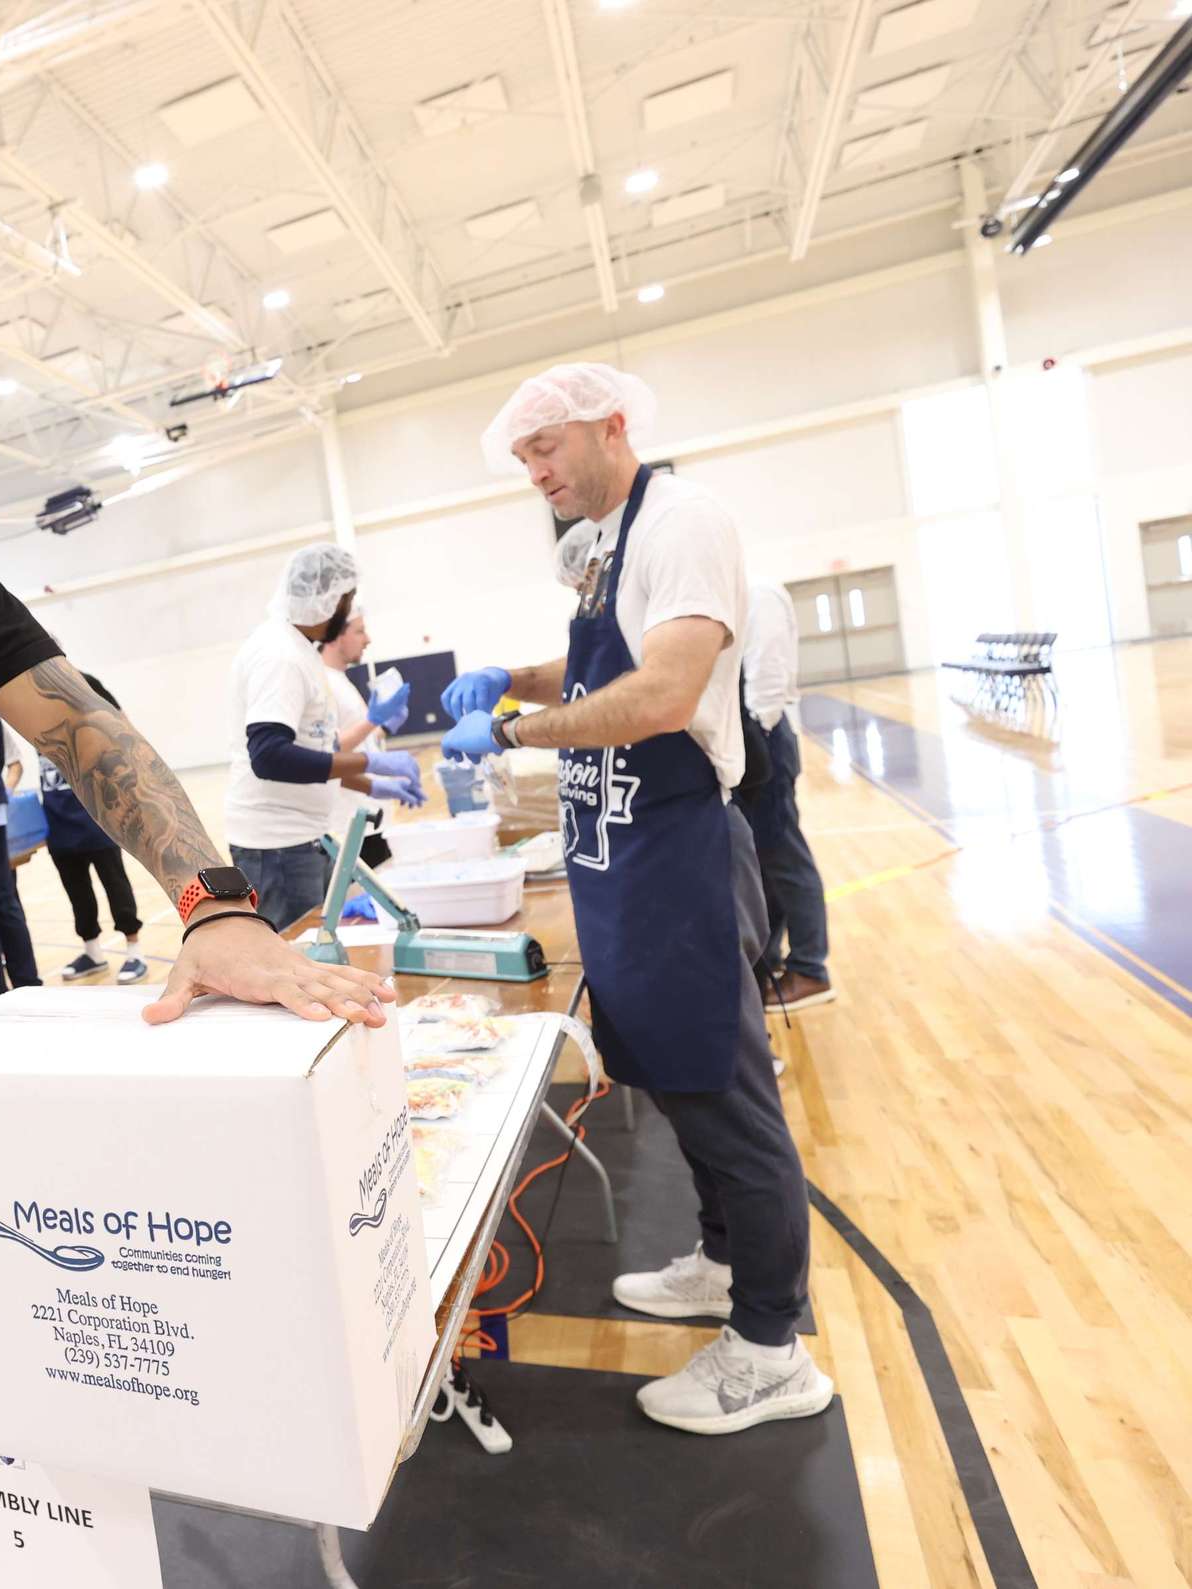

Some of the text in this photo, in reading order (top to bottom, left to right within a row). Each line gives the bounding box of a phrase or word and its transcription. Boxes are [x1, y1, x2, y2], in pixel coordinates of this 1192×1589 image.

[359, 1151, 382, 1210] Meals
[13, 1201, 232, 1246] Meals of Hope
[111, 1260, 232, 1280] together to end hunger!
[119, 1247, 222, 1267] Communities coming
[56, 1288, 159, 1318] Meals of Hope
[31, 1304, 195, 1340] 2221 Corporation Blvd.
[53, 1326, 175, 1358] Naples, FL 34109
[64, 1346, 171, 1377] (239) 537-7775
[45, 1366, 200, 1406] www.mealsofhope.org
[47, 1502, 95, 1529] LINE
[13, 1530, 25, 1549] 5
